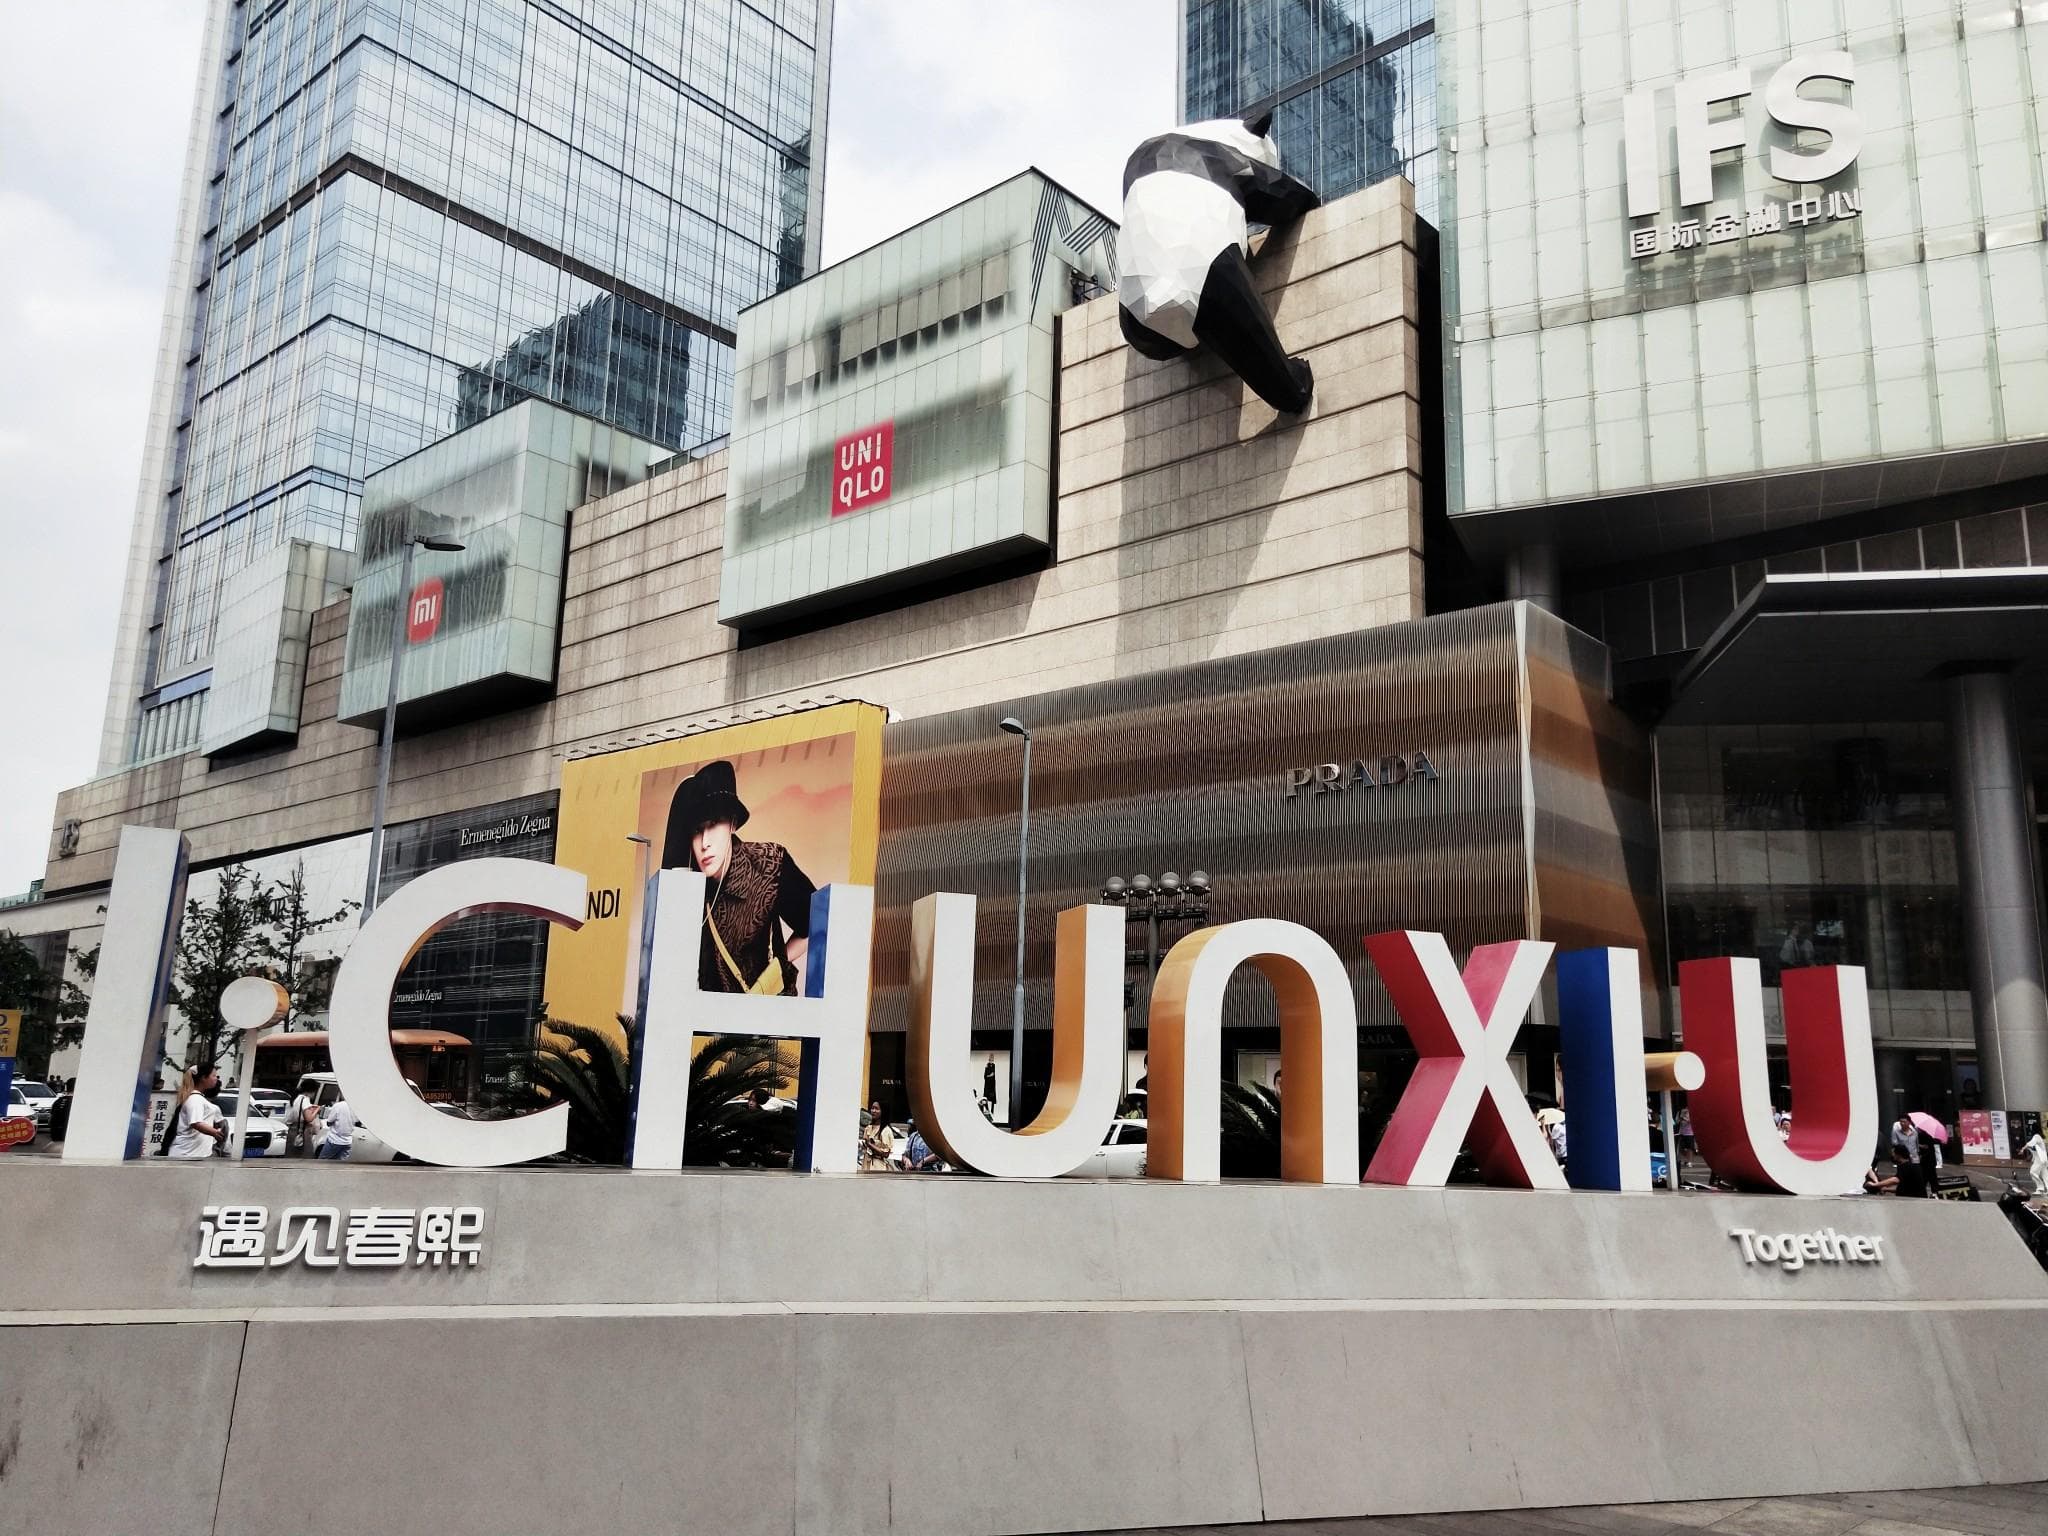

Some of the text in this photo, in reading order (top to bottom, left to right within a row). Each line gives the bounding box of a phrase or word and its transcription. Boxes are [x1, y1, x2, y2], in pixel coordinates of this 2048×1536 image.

[1623, 49, 1863, 219] IFS
[1629, 186, 1864, 259] 国际金融中心
[841, 432, 882, 471] UNI
[839, 465, 885, 507] QLO
[1286, 750, 1440, 797] PRADA
[460, 814, 551, 847] Ermenegildo Zegna
[587, 888, 621, 920] NDI
[150, 1100, 168, 1144] 禁止停放
[193, 1205, 485, 1267] 遇见春熙
[1729, 1227, 1884, 1271] Together
